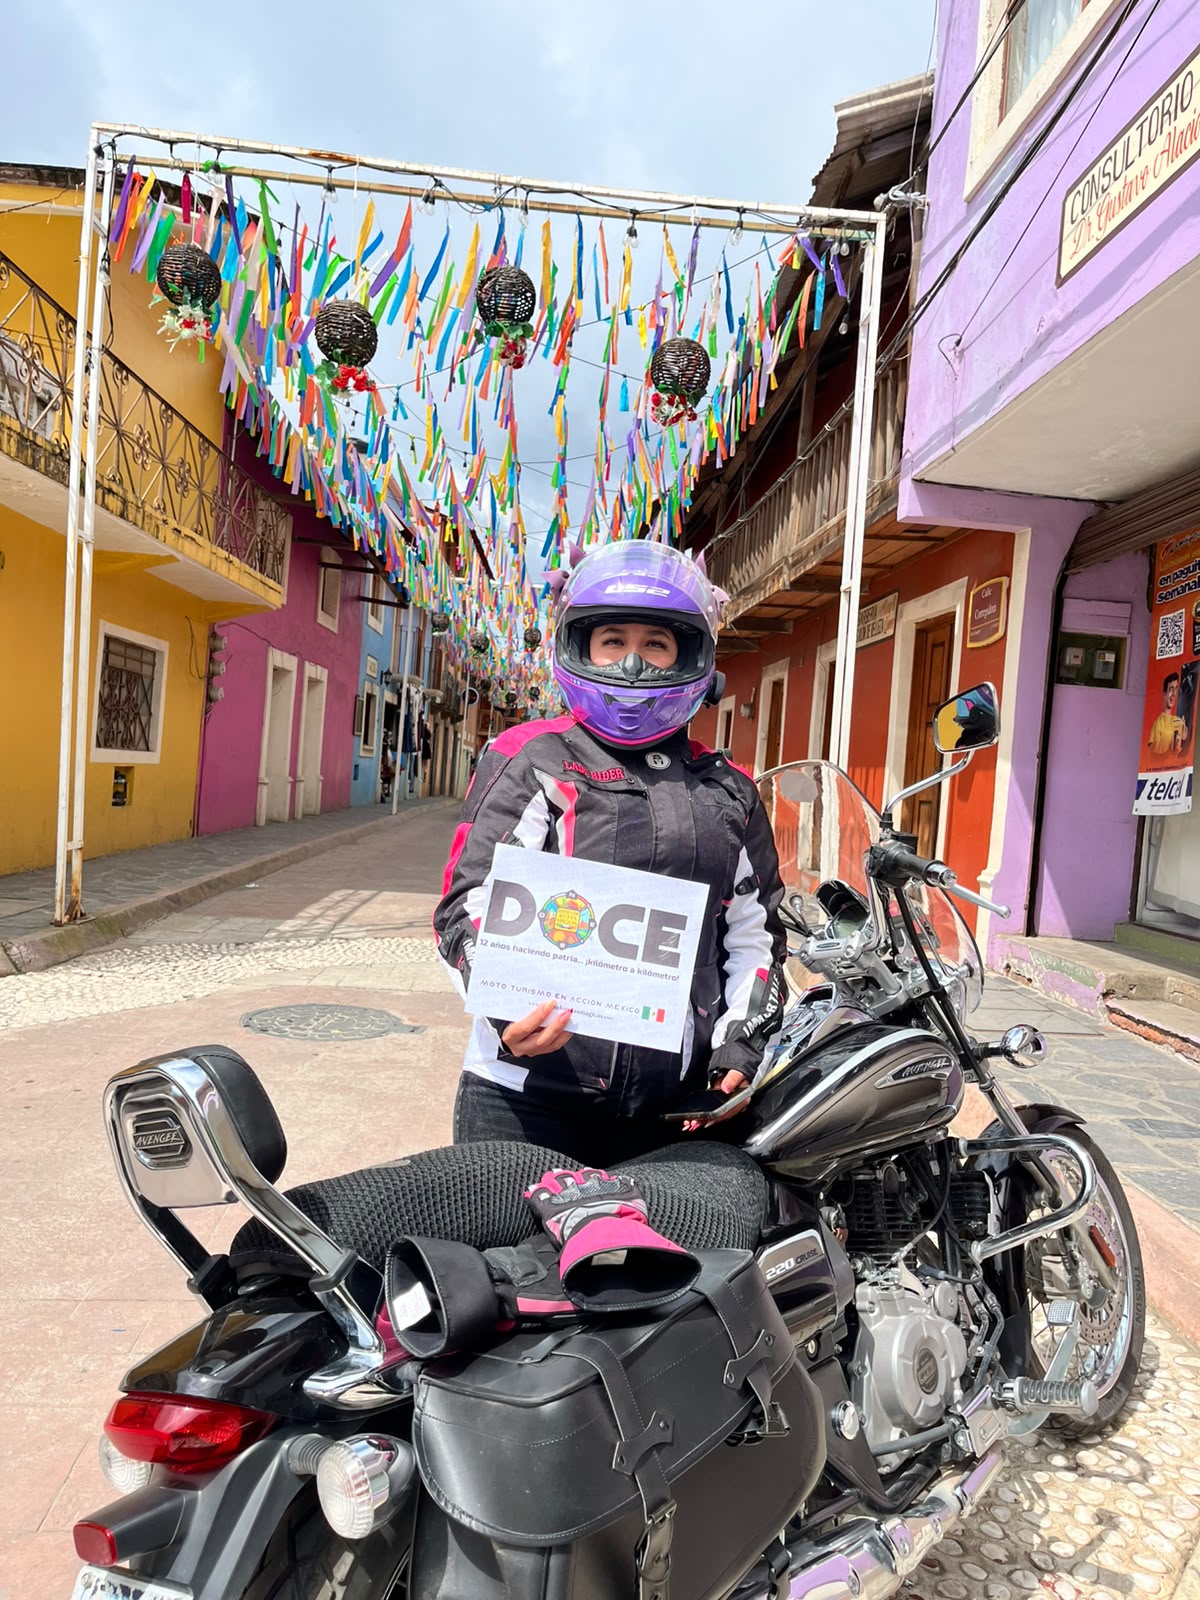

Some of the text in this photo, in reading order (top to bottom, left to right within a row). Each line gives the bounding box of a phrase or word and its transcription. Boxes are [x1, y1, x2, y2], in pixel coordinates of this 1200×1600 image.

[1070, 70, 1194, 225] CONSULTORIO
[1096, 164, 1150, 241] Gustavo
[981, 587, 993, 599] Calle
[590, 768, 625, 782] RIDER
[480, 938, 489, 946] 12
[490, 940, 511, 951] años
[512, 944, 551, 958] haciendo
[480, 979, 507, 990] MOTO
[510, 984, 552, 998] TURISMO
[554, 992, 567, 1001] EN
[569, 996, 602, 1009] ACCION
[604, 1002, 641, 1015] MEXICO
[765, 1247, 819, 1281] 220 CRUISE
